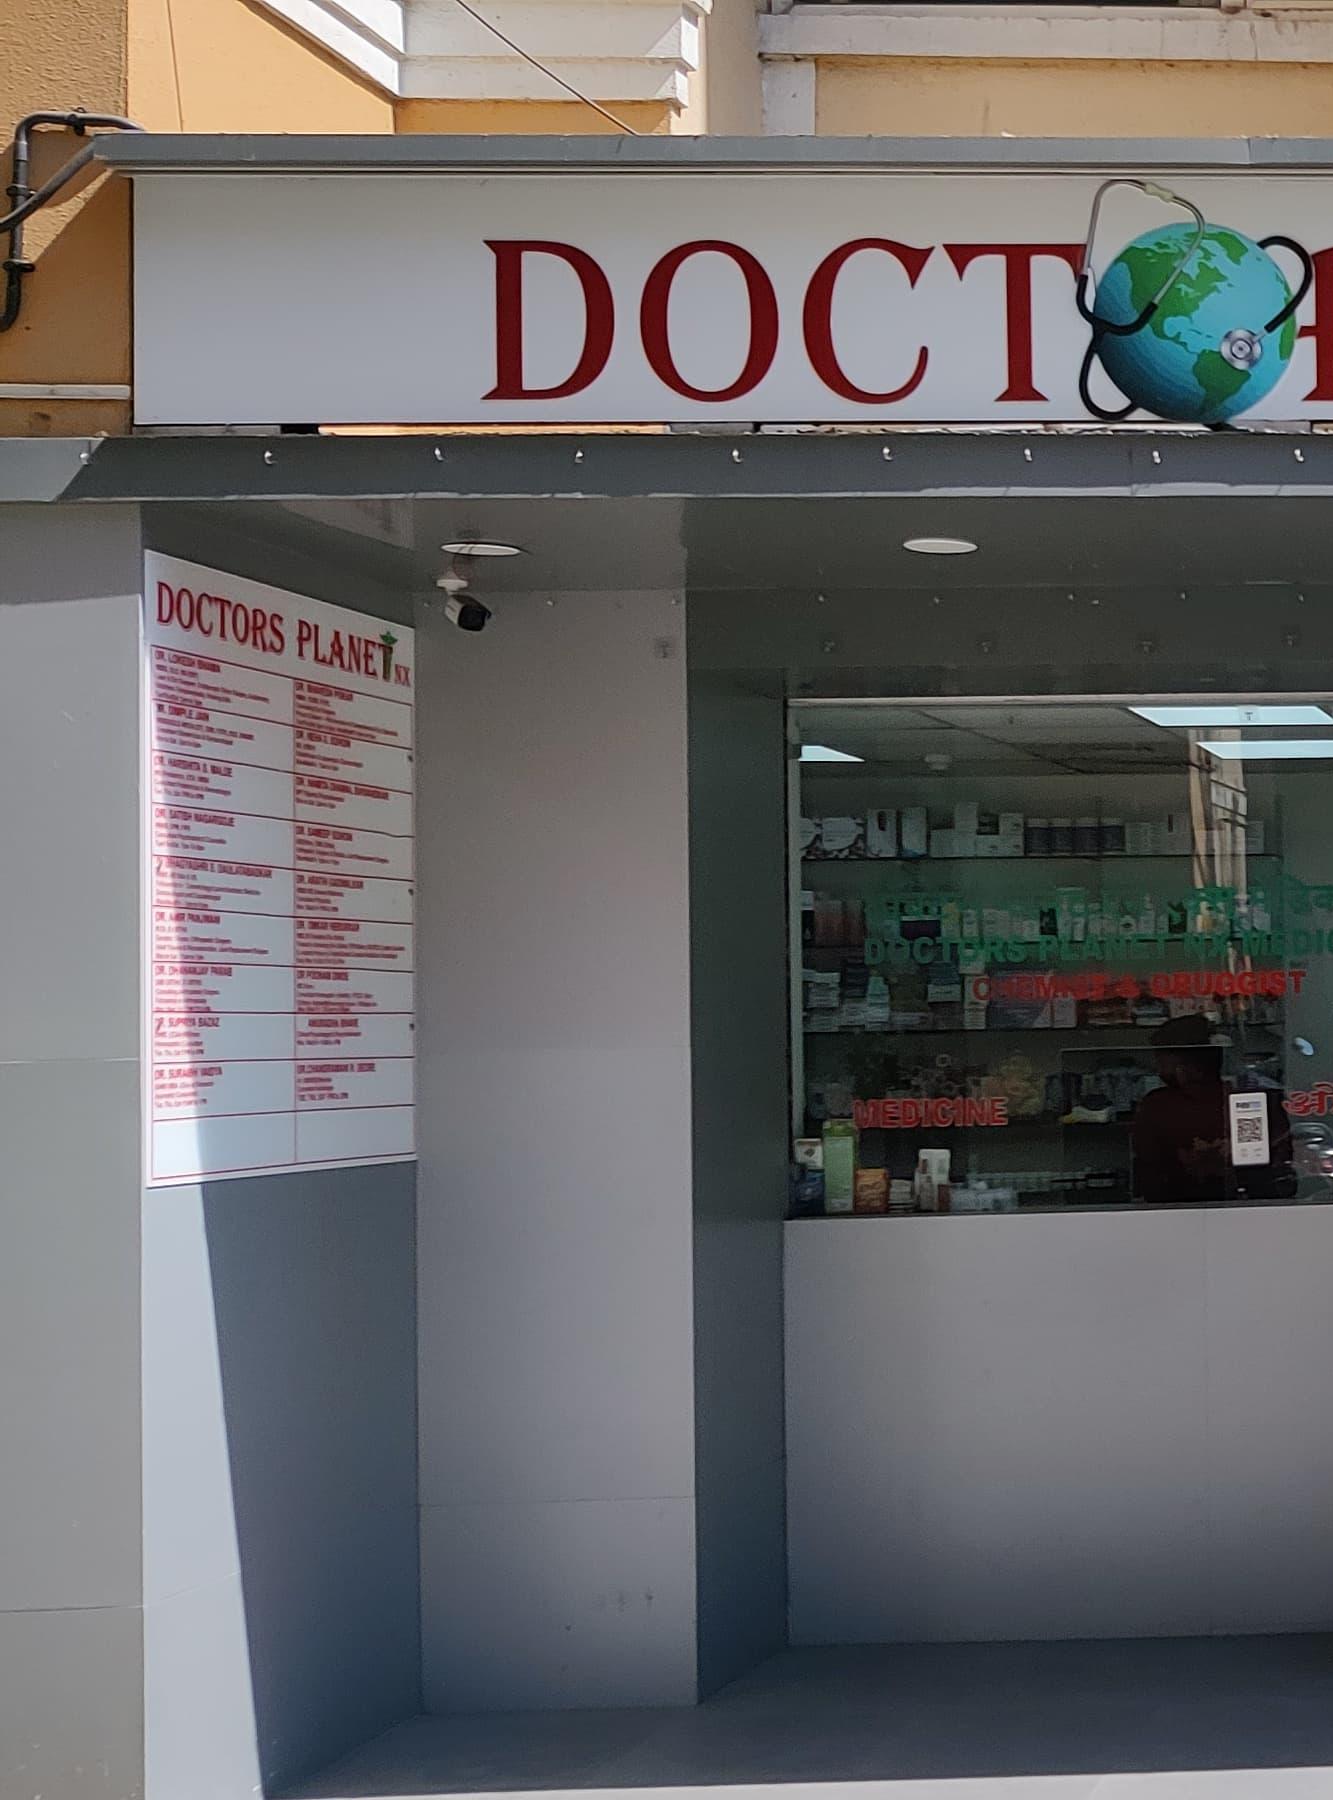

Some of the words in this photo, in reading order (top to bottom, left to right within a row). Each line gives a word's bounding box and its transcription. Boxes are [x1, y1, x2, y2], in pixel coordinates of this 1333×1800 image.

[156, 581, 285, 655] DOCTORS
[297, 619, 393, 683] PLANET
[395, 664, 411, 686] NX
[1150, 968, 1306, 998] DRUGGIST
[852, 1097, 1009, 1129] MEDICINE
